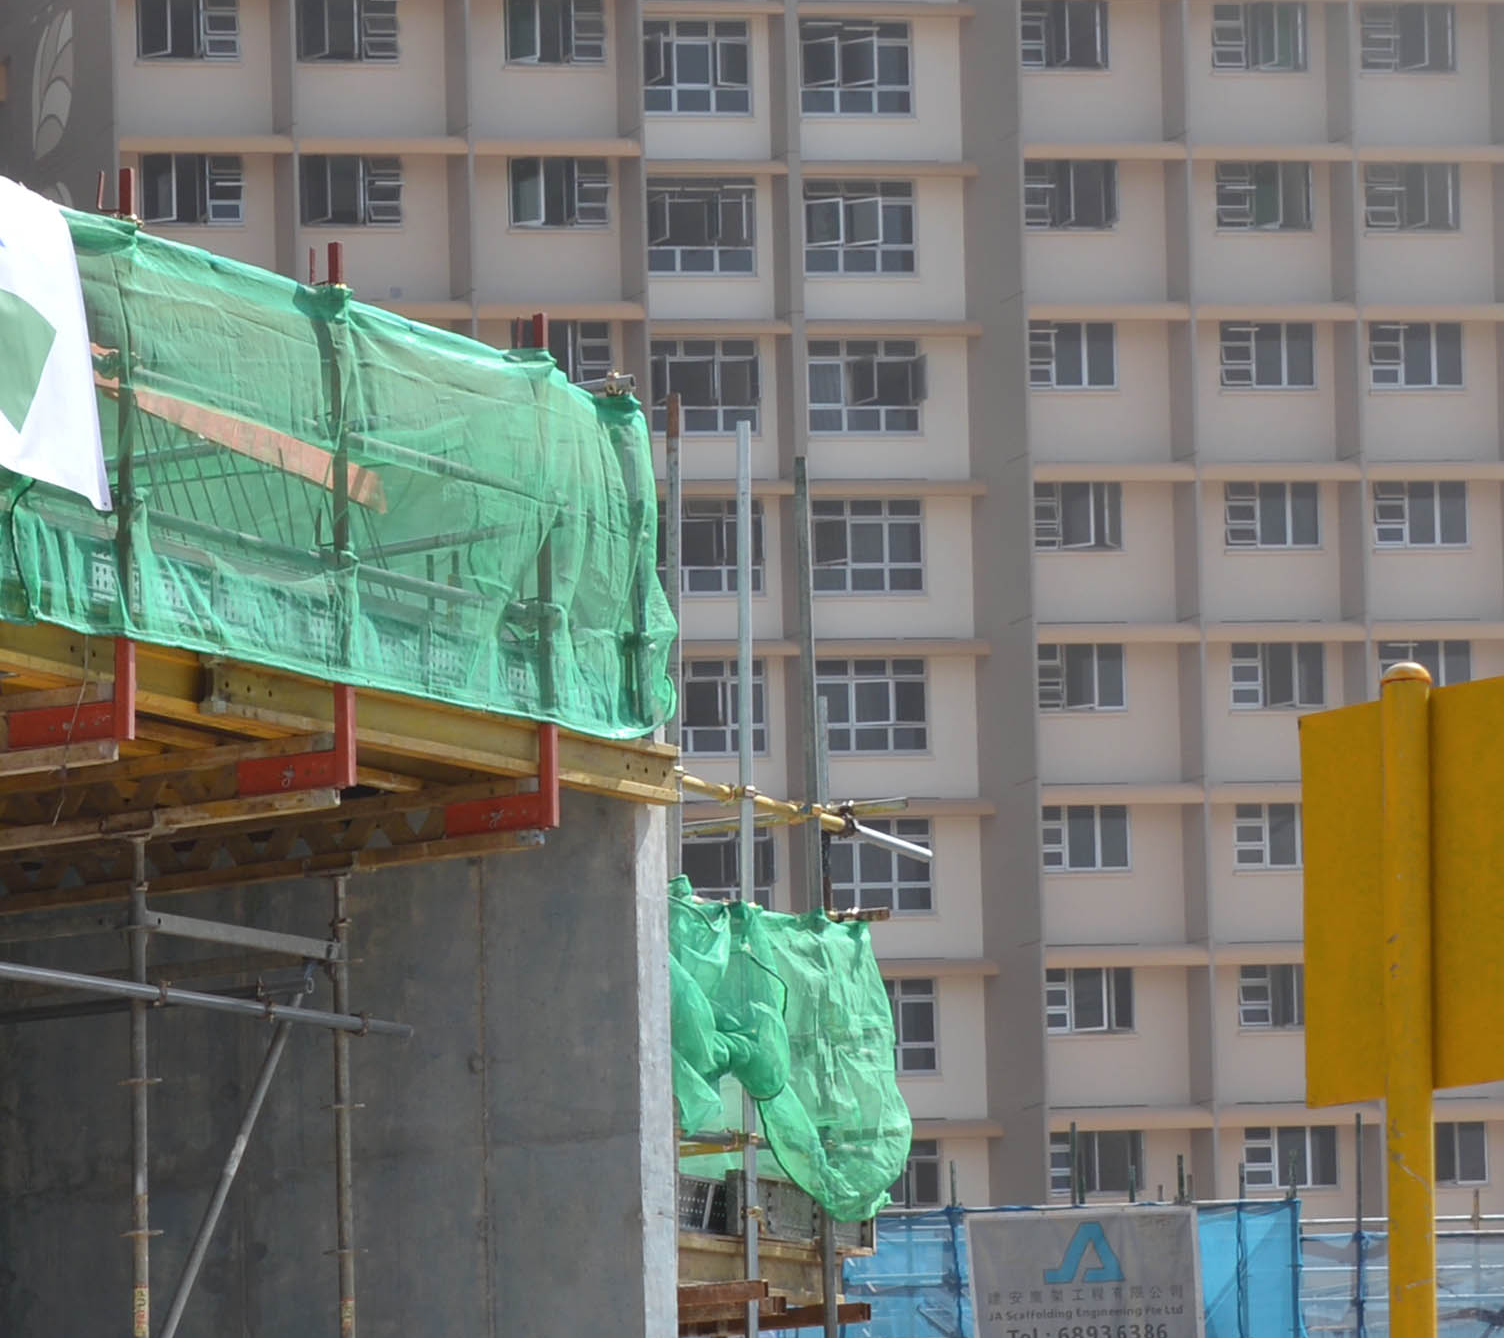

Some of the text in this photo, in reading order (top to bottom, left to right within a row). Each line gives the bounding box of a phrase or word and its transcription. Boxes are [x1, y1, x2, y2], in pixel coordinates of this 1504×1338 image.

[1007, 1307, 1073, 1322] Scaffolding
[1076, 1305, 1142, 1320] Engineering
[1165, 1304, 1184, 1316] Ltd
